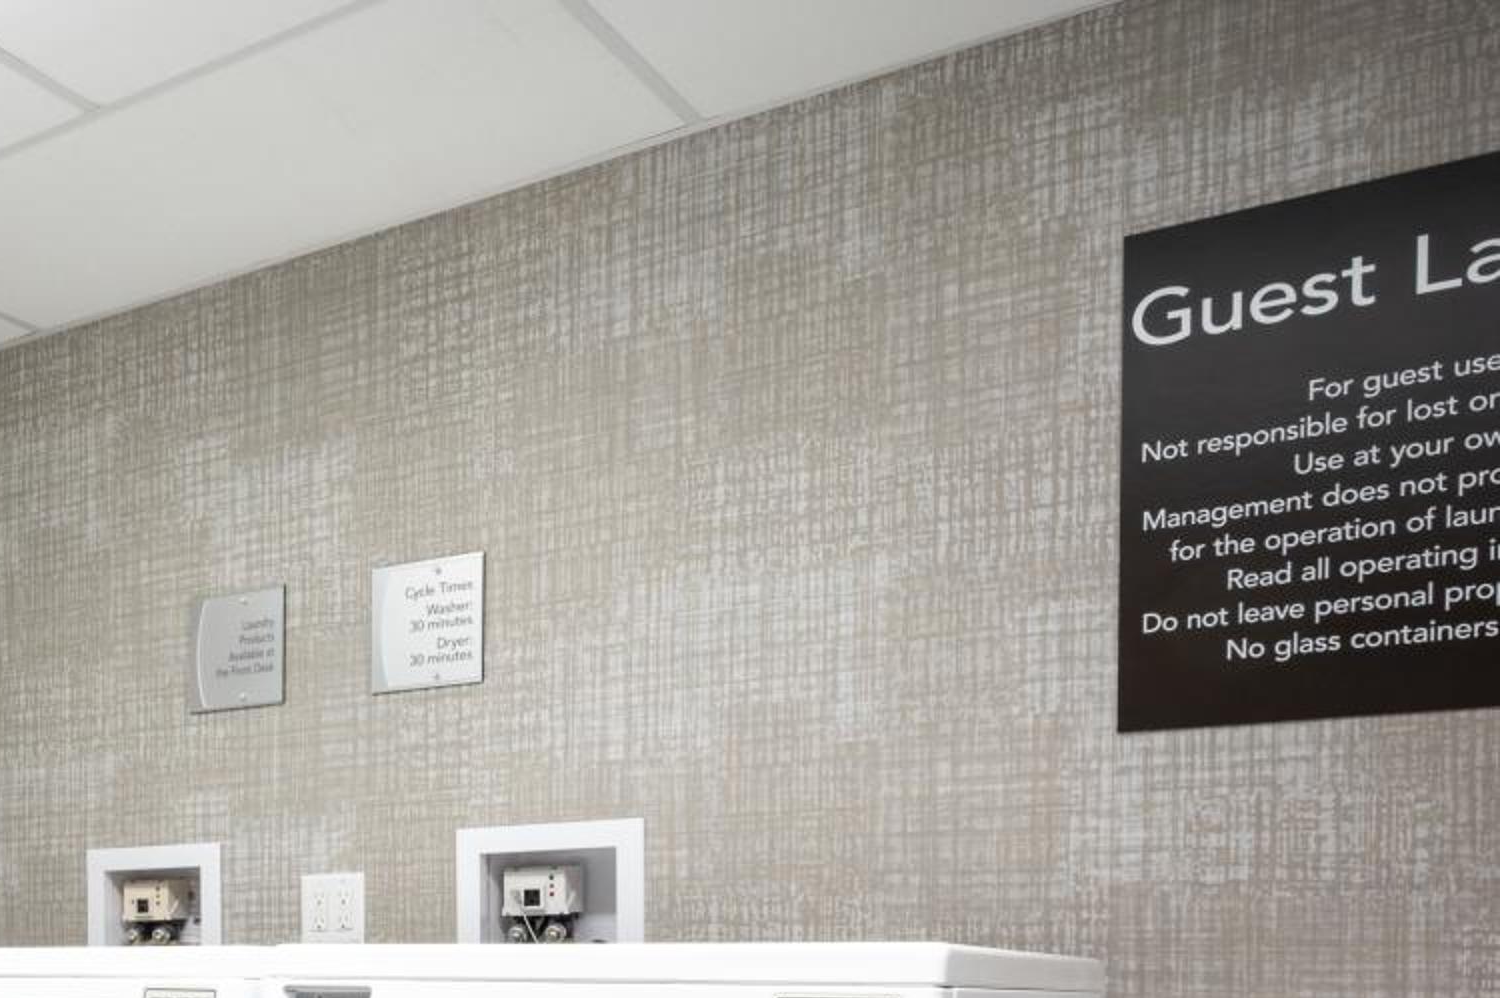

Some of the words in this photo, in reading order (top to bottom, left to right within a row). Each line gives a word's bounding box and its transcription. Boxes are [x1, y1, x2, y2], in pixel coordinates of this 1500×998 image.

[1132, 255, 1376, 346] Guest
[1309, 378, 1354, 401] For
[1363, 360, 1444, 398] guest
[1141, 438, 1189, 463] Not
[1197, 412, 1348, 456] responsible
[1357, 405, 1397, 430] for
[1407, 395, 1459, 422] lost
[1293, 451, 1345, 475] Use
[1353, 445, 1382, 466] at
[1389, 434, 1456, 468] your
[1143, 490, 1314, 531] Management
[1322, 480, 1391, 508] does
[1399, 471, 1448, 497] not
[1169, 539, 1206, 563] for
[1213, 533, 1256, 558] the
[1265, 518, 1396, 556] operation
[1406, 505, 1437, 532] of
[1227, 561, 1293, 590] Read
[1301, 557, 1331, 583] all
[1339, 545, 1479, 583] operating
[404, 584, 436, 602] Cycle
[1143, 612, 1178, 634] Do
[1187, 607, 1229, 631] not
[1238, 601, 1305, 625] leave
[1314, 581, 1434, 624] personal
[1444, 580, 1500, 611] pro
[409, 620, 425, 633] 30
[428, 616, 474, 630] minutes
[1226, 638, 1266, 661] No
[1274, 631, 1342, 663] glass
[1350, 619, 1499, 649] containers
[409, 653, 425, 667] 30
[428, 650, 474, 664] minutes
